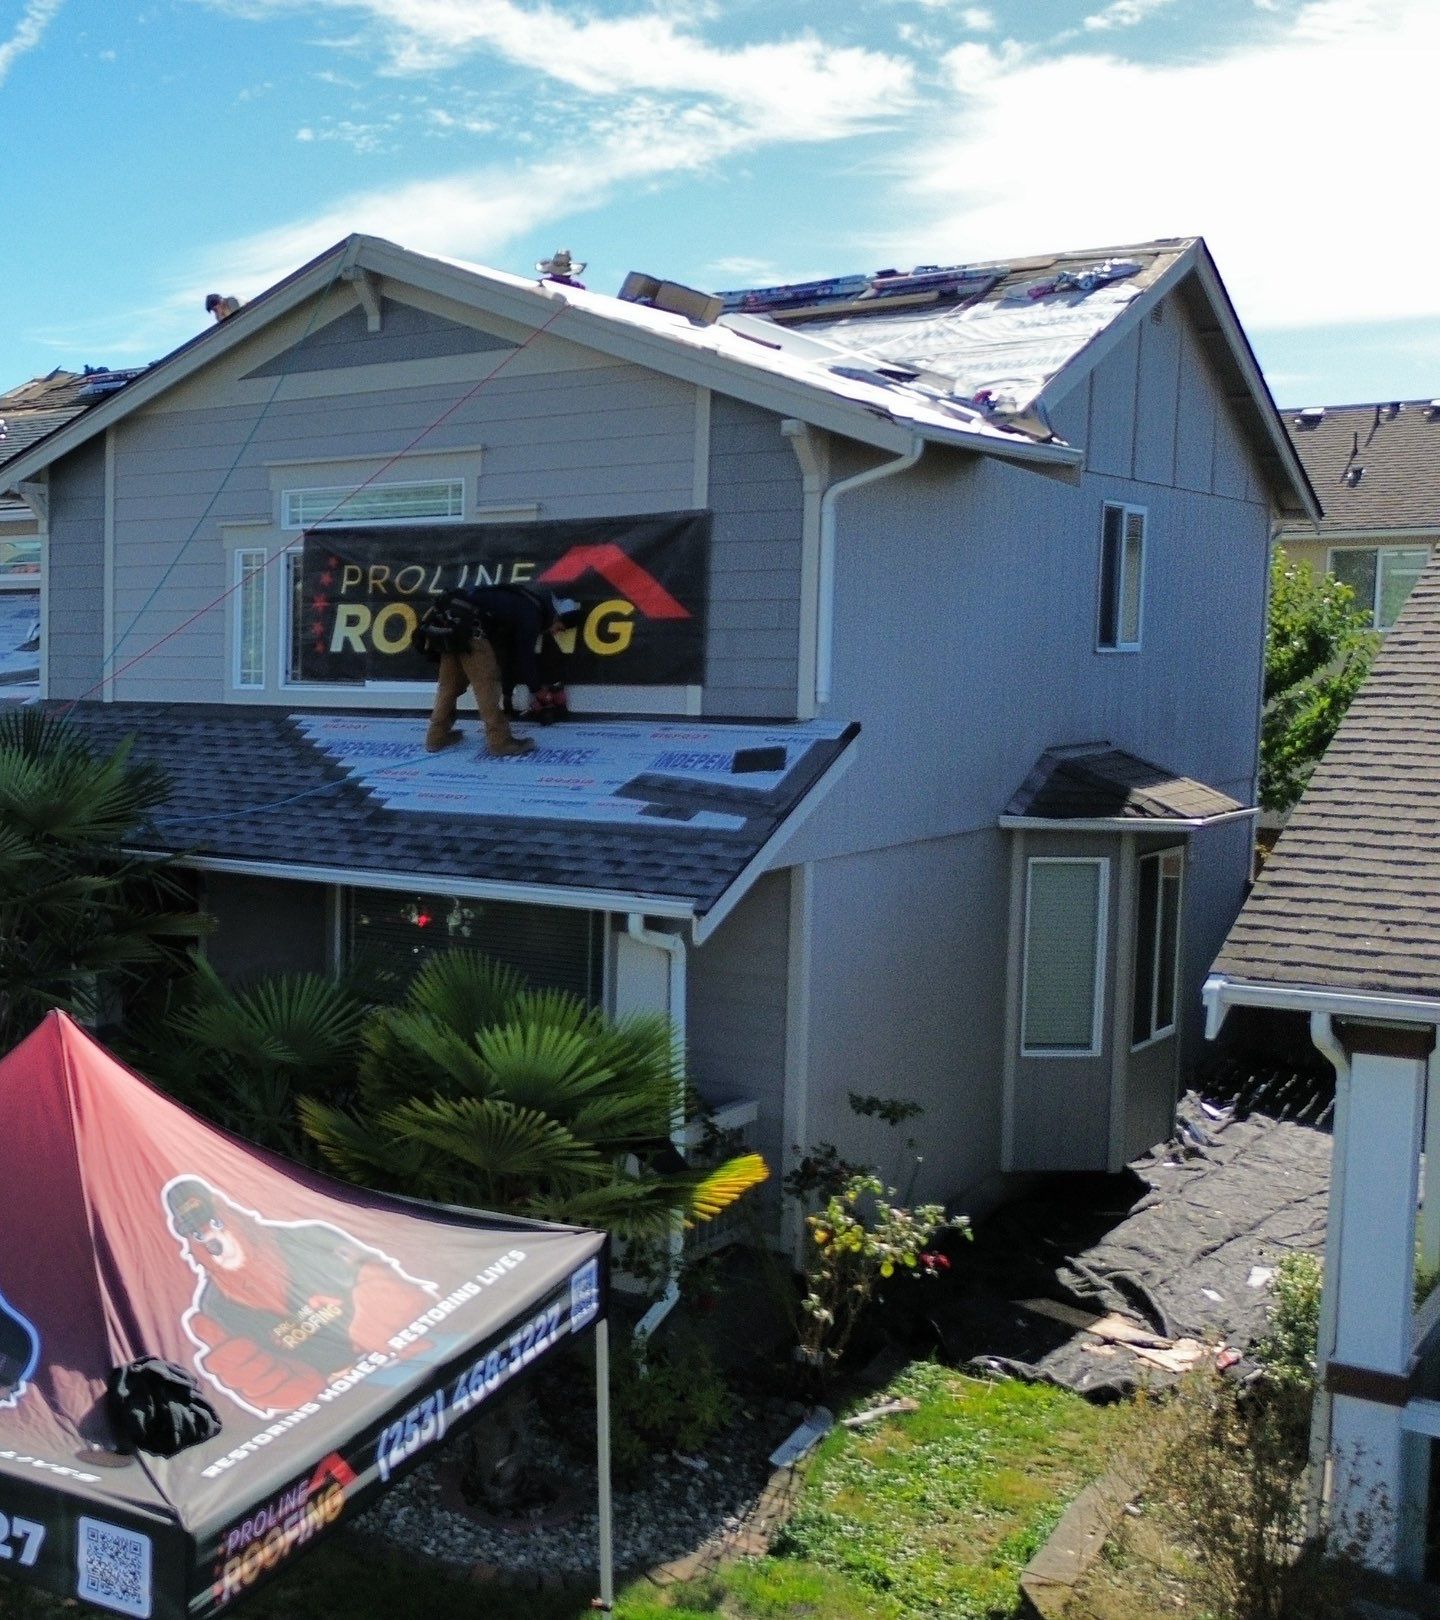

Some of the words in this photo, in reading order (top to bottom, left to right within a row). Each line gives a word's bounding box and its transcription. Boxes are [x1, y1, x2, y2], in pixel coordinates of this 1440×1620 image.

[341, 563, 535, 594] PROLINE
[201, 1402, 321, 1479] RESTORING
[388, 1281, 482, 1350] RESTORING
[477, 1248, 528, 1288] LIVES
[282, 1303, 343, 1349] ROOFING
[375, 1387, 446, 1483] (253)
[452, 1302, 561, 1412] 468-3227
[221, 1481, 346, 1603] ROOFING
[226, 1479, 311, 1558] PROLINE
